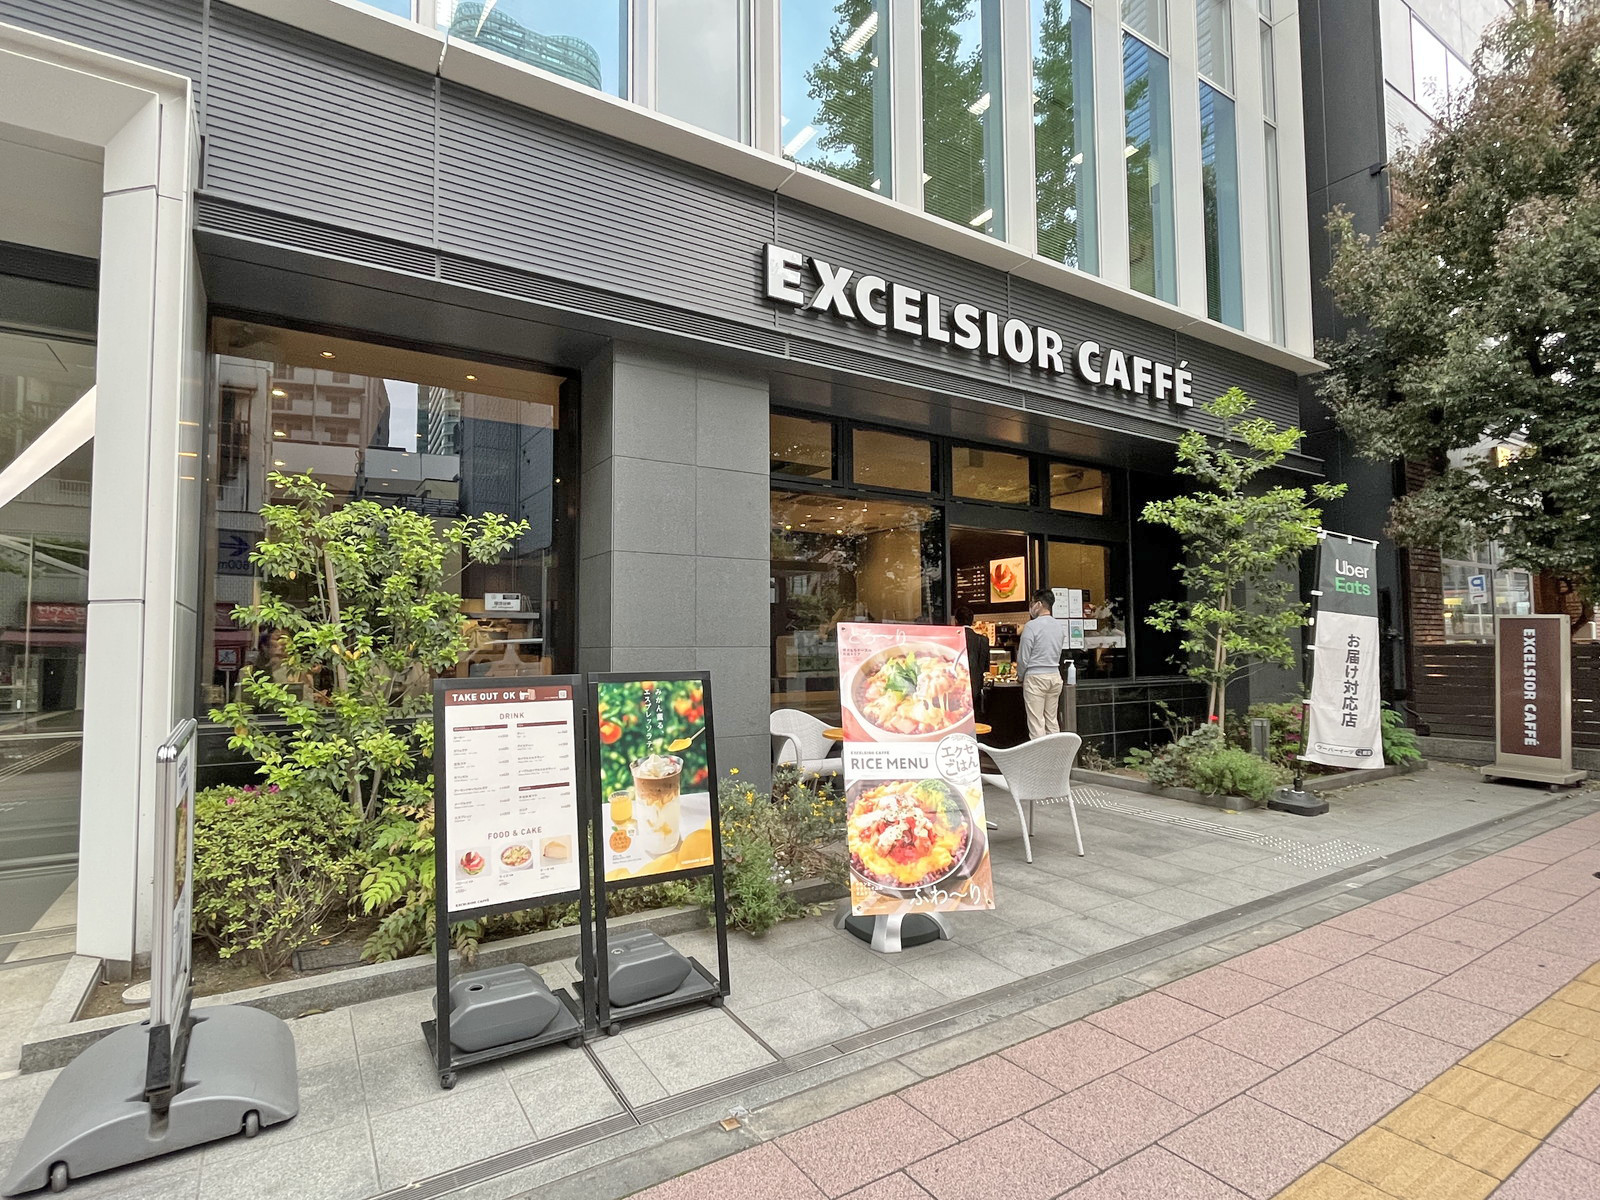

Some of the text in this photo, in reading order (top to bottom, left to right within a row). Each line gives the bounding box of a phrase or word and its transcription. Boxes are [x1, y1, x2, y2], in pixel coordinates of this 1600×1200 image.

[763, 242, 1194, 407] EXCELSIOR CAFFÉ
[1335, 558, 1370, 579] Uber
[1334, 577, 1371, 596] Eats
[1341, 634, 1361, 728] お届け対応店
[1523, 628, 1539, 747] EXCELSIOR CAFFÉ
[452, 691, 516, 702] TAKE OUT OK
[499, 712, 525, 720] DRINK
[941, 744, 974, 758] エクセ
[851, 757, 929, 770] RICE MENU
[945, 757, 978, 776] ごはん
[488, 826, 542, 840] FOOD & CAKE
